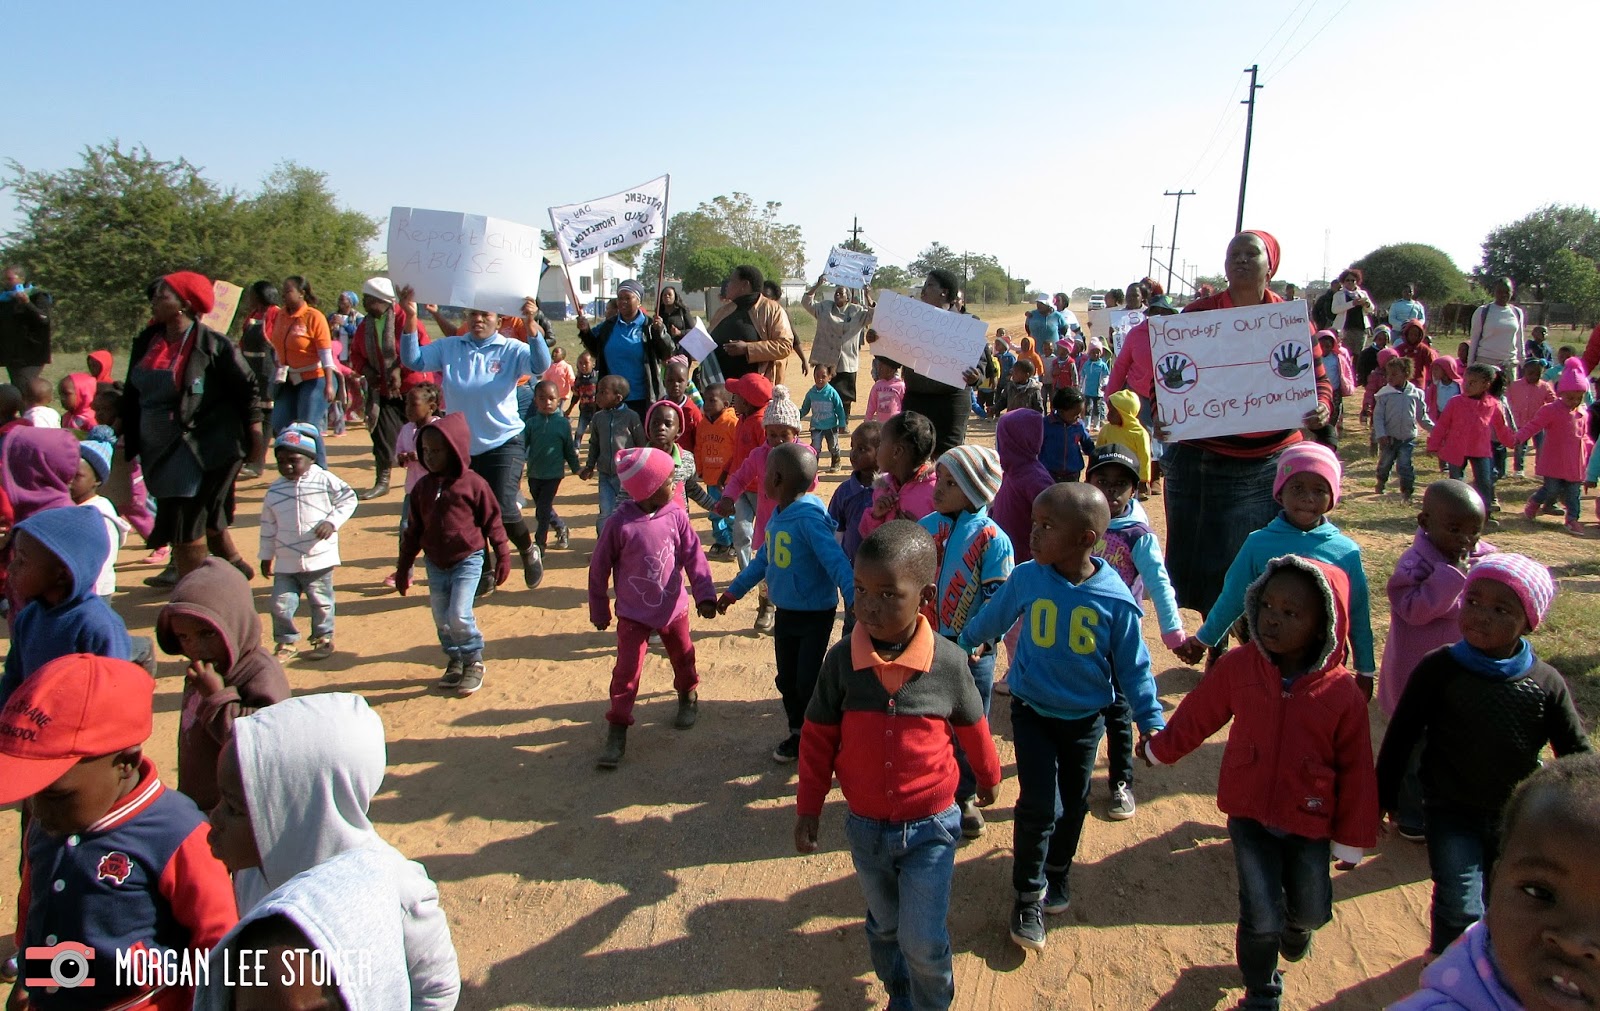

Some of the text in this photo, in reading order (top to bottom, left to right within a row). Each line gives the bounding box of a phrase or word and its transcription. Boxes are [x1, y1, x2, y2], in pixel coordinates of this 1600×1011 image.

[398, 219, 533, 258] Report Child
[402, 252, 502, 274] ABUSE
[1158, 397, 1200, 427] We
[1203, 398, 1239, 418] Care
[1242, 393, 1265, 416] for
[940, 569, 967, 629] IRON
[1031, 598, 1098, 654] 06
